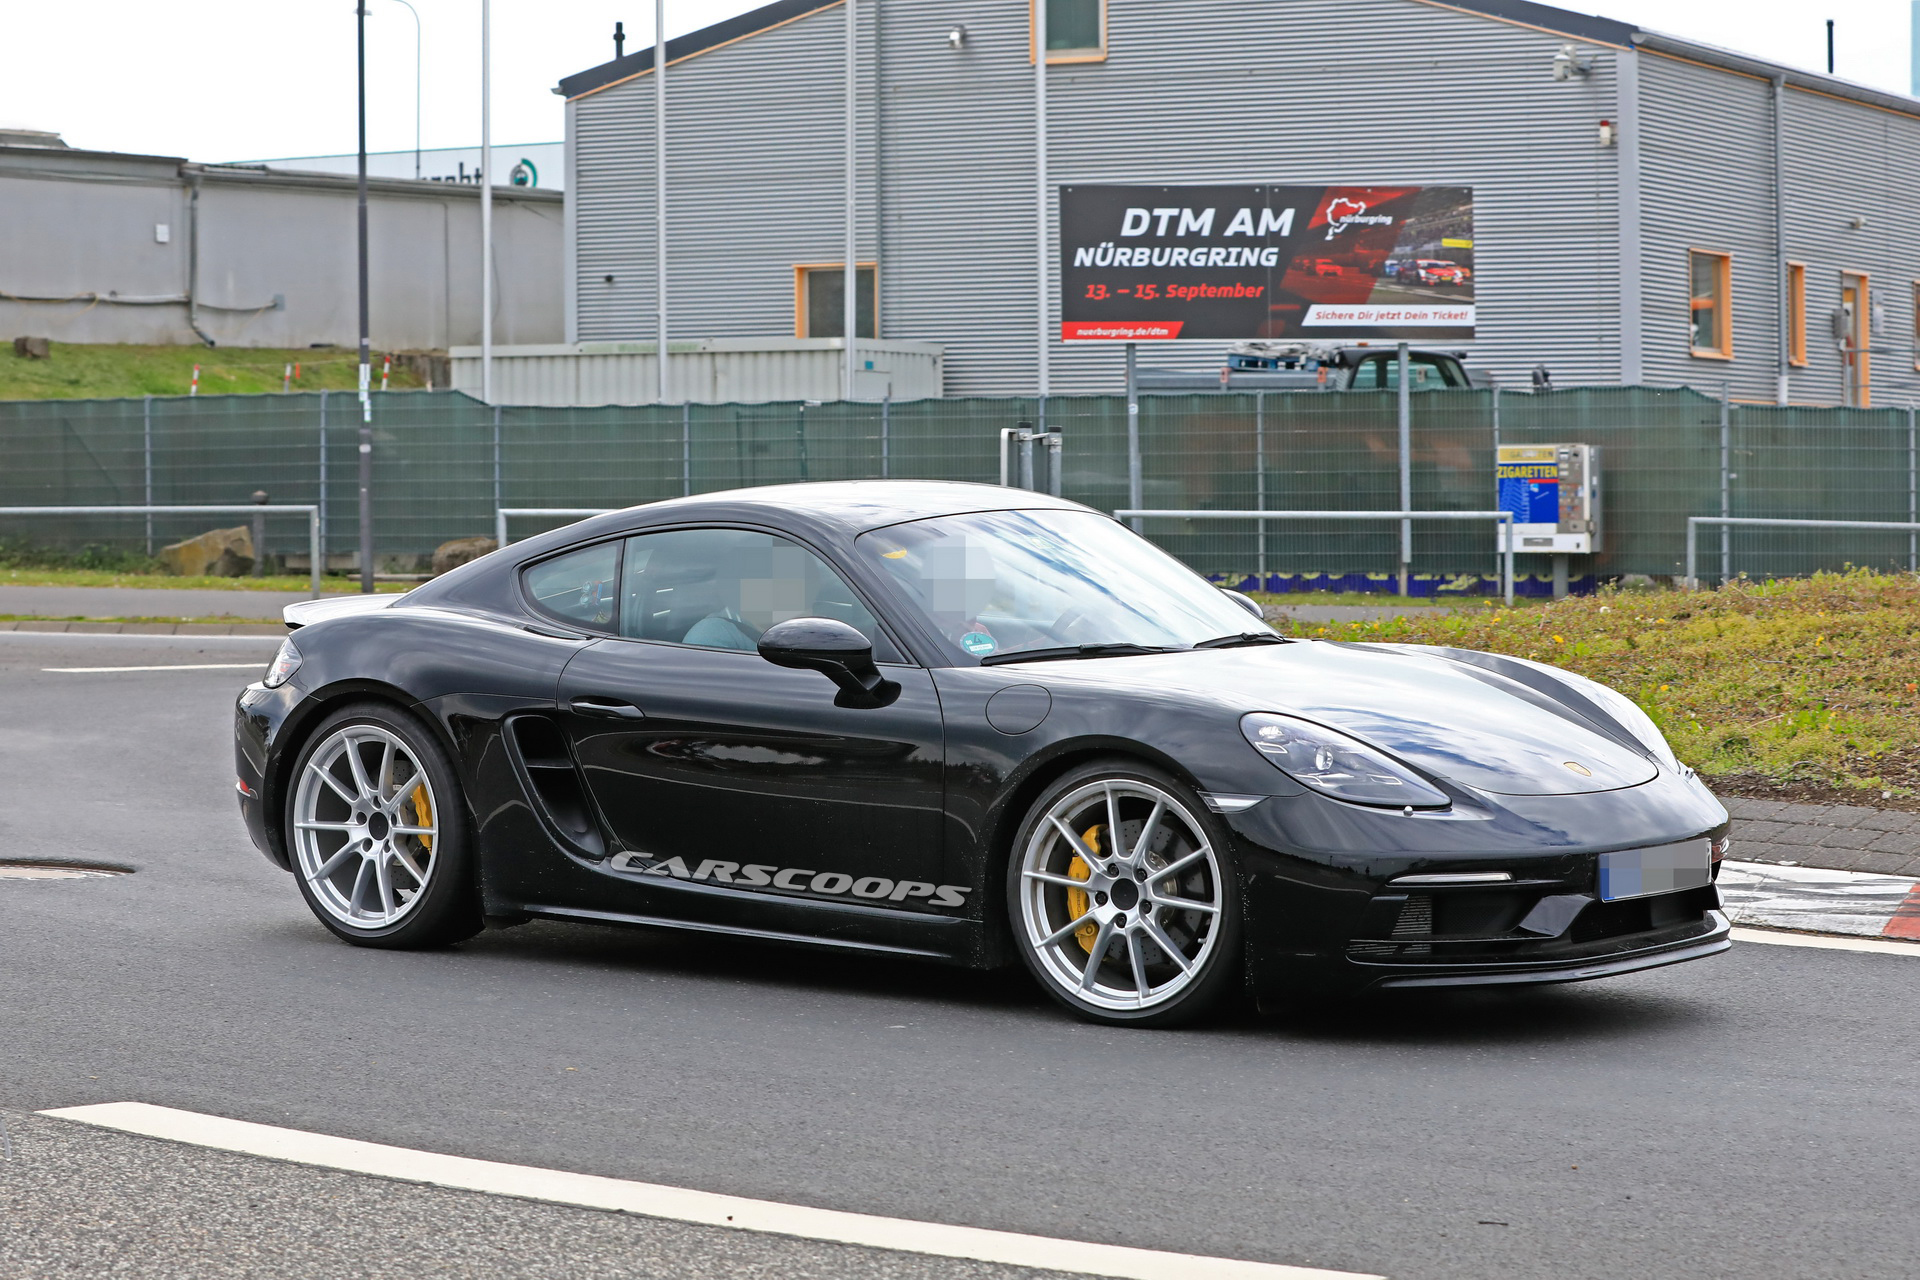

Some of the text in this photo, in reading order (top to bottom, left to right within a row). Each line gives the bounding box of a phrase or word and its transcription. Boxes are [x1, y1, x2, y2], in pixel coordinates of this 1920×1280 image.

[1120, 207, 1296, 237] DTM AM
[1339, 214, 1393, 226] nürburgring
[1073, 241, 1279, 267] NÜRBURGRING
[1084, 284, 1111, 300] 13.
[1134, 284, 1160, 300] 15.
[1165, 282, 1264, 301] September
[1315, 311, 1468, 322] Sichere Dir jetzt Dein Ticket!
[1076, 327, 1169, 337] nuerburgring.de/dtm
[1497, 465, 1558, 479] ZIGARETTEN
